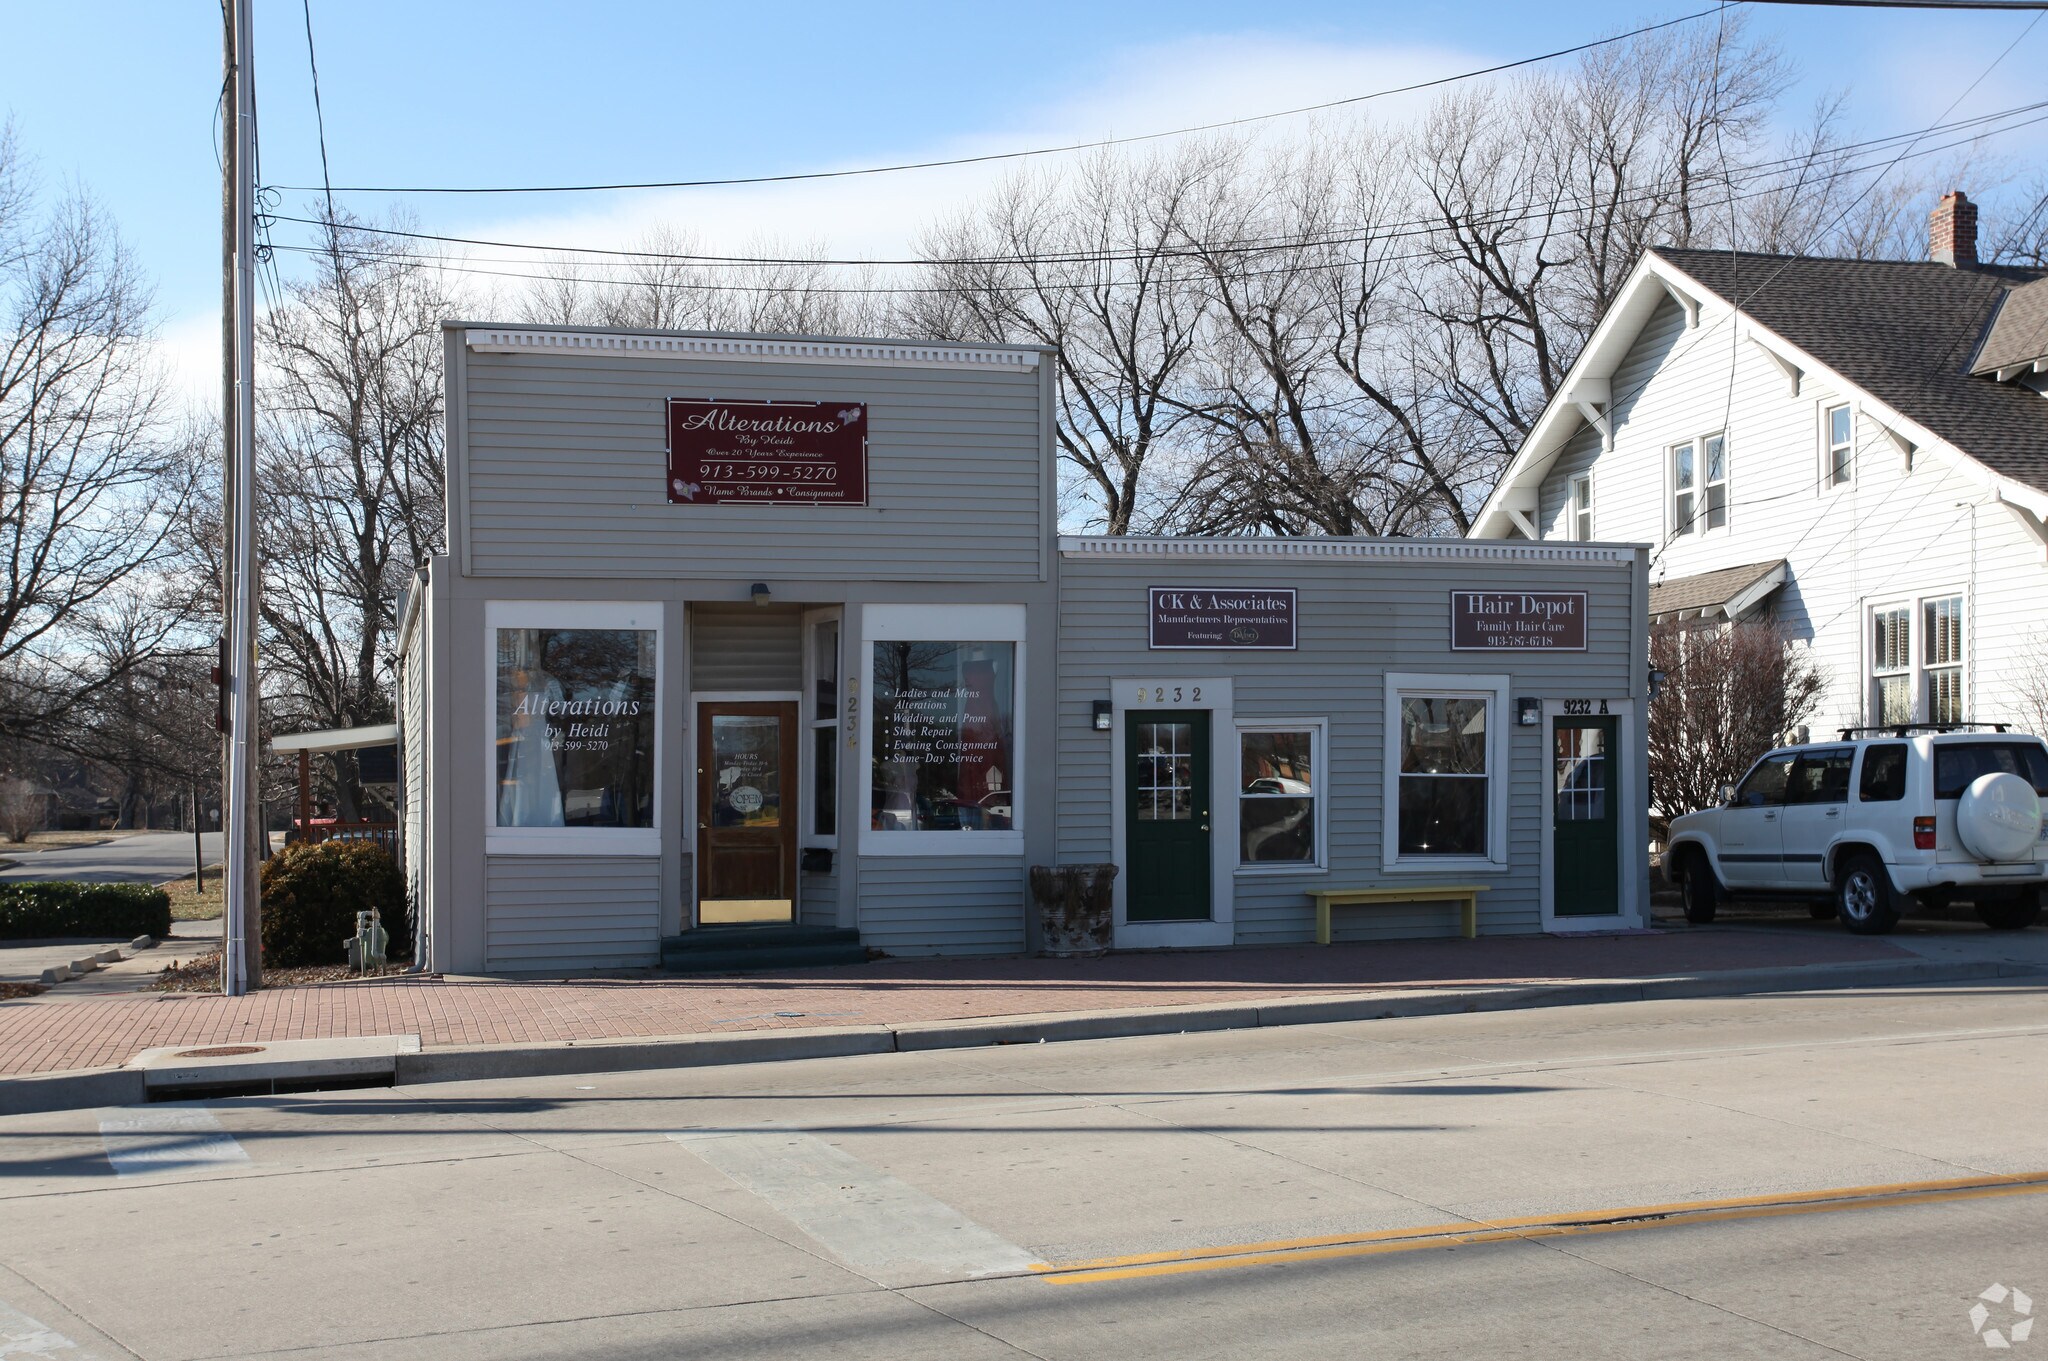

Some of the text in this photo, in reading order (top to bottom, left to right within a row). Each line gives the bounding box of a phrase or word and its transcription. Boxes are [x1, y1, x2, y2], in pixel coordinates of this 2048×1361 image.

[682, 408, 840, 433] Alterations
[735, 434, 796, 447] By Heidi
[706, 448, 824, 459] Over 20 Years Experience
[699, 464, 838, 481] 913-599-5270
[704, 485, 846, 500] Name Brands Consignment
[1158, 593, 1287, 610] CK & Associates
[1467, 595, 1575, 620] Hair Depot
[1158, 614, 1288, 626] Manufacturers Representatives
[1476, 620, 1565, 634] Family Hair Care
[1187, 631, 1223, 641] Featuring
[1488, 636, 1553, 647] 913-787-6718
[894, 688, 980, 699] Ladies and Mens
[1137, 686, 1202, 703] 9232
[513, 694, 641, 716] Alterations
[894, 700, 948, 710] Alterations
[1563, 699, 1609, 715] 9232 A
[892, 713, 987, 725] Wedding and Prom
[544, 723, 610, 739] by Heidi
[893, 726, 953, 738] Shoe Repair
[544, 740, 609, 752] 913-599-5270
[893, 740, 998, 752] Evening Consignment
[892, 753, 984, 765] Same-Day Service
[735, 794, 762, 804] OPEN
